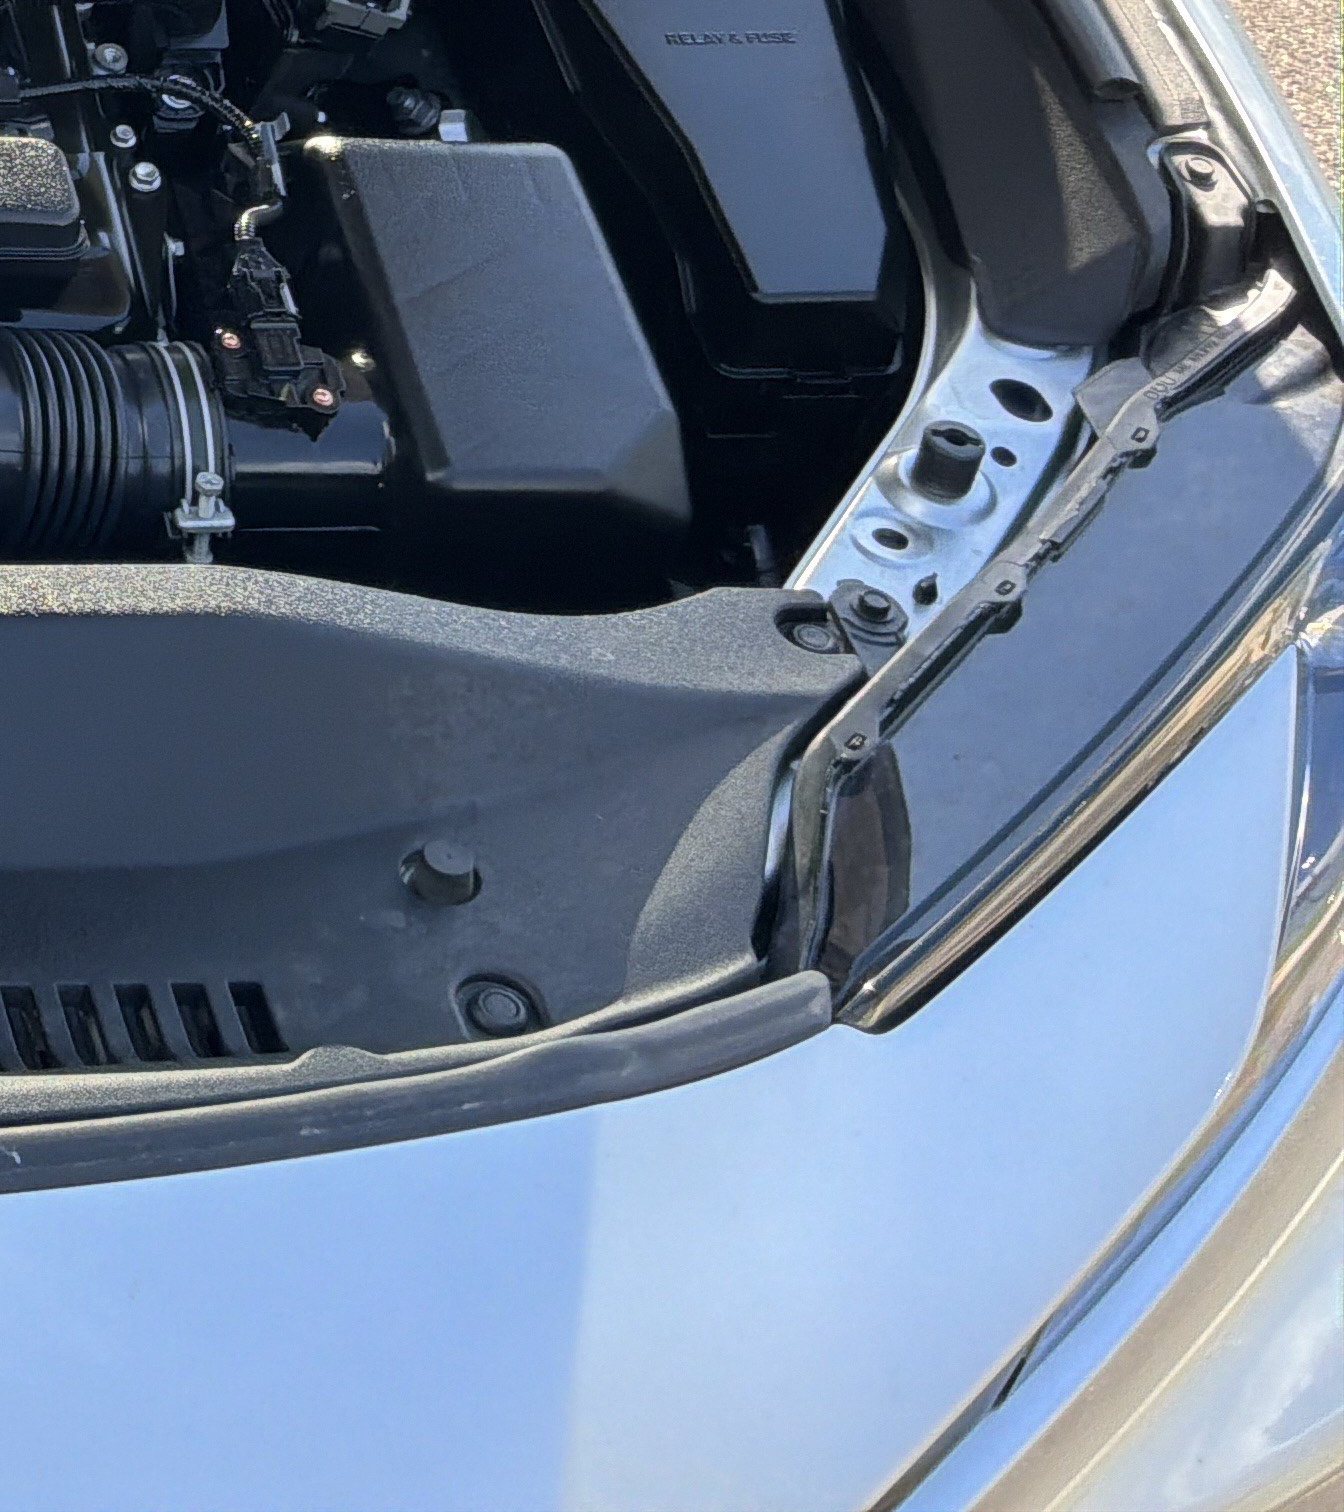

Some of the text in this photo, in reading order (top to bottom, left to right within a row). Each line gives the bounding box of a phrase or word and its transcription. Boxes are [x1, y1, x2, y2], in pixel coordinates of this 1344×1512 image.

[664, 30, 797, 45] RELAY & FUSE
